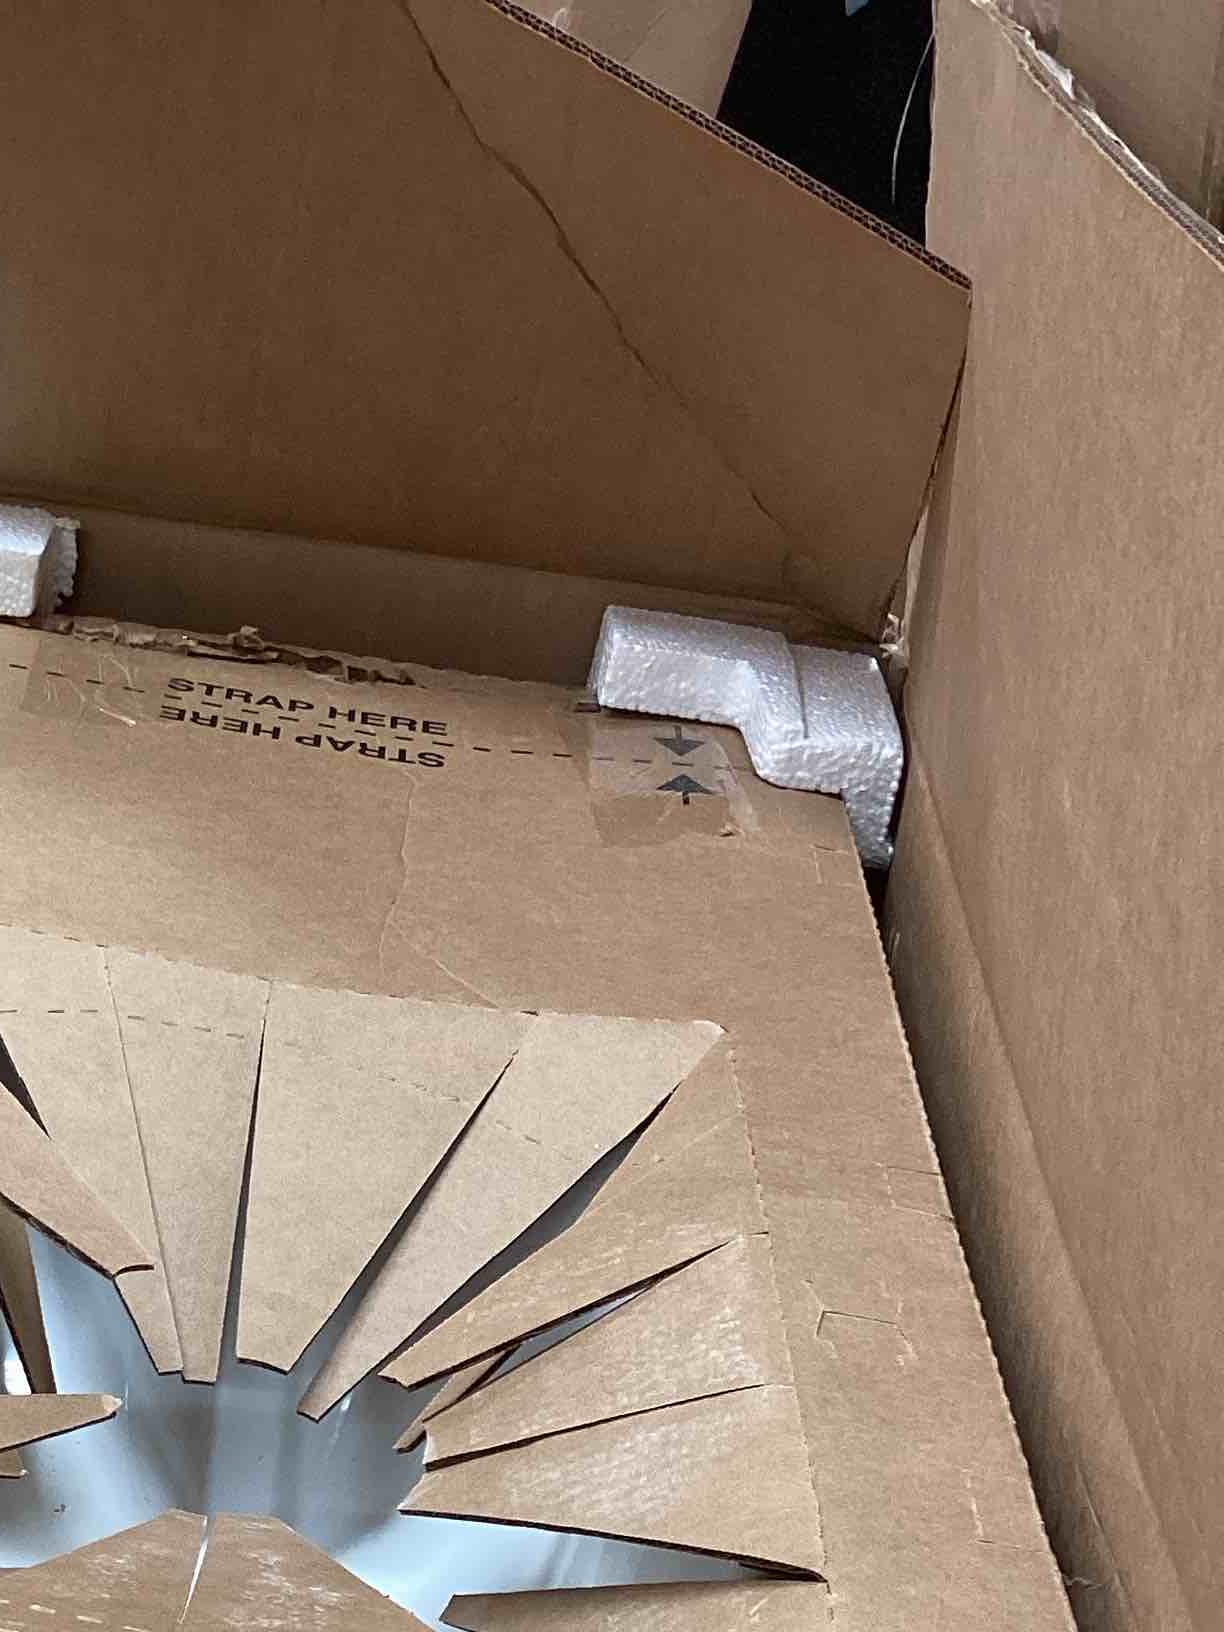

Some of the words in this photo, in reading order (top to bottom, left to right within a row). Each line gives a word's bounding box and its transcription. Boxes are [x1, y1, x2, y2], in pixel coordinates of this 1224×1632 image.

[159, 705, 281, 740] HERE
[167, 677, 315, 712] STRAP
[327, 706, 448, 736] HERE
[295, 734, 446, 768] STRAP
